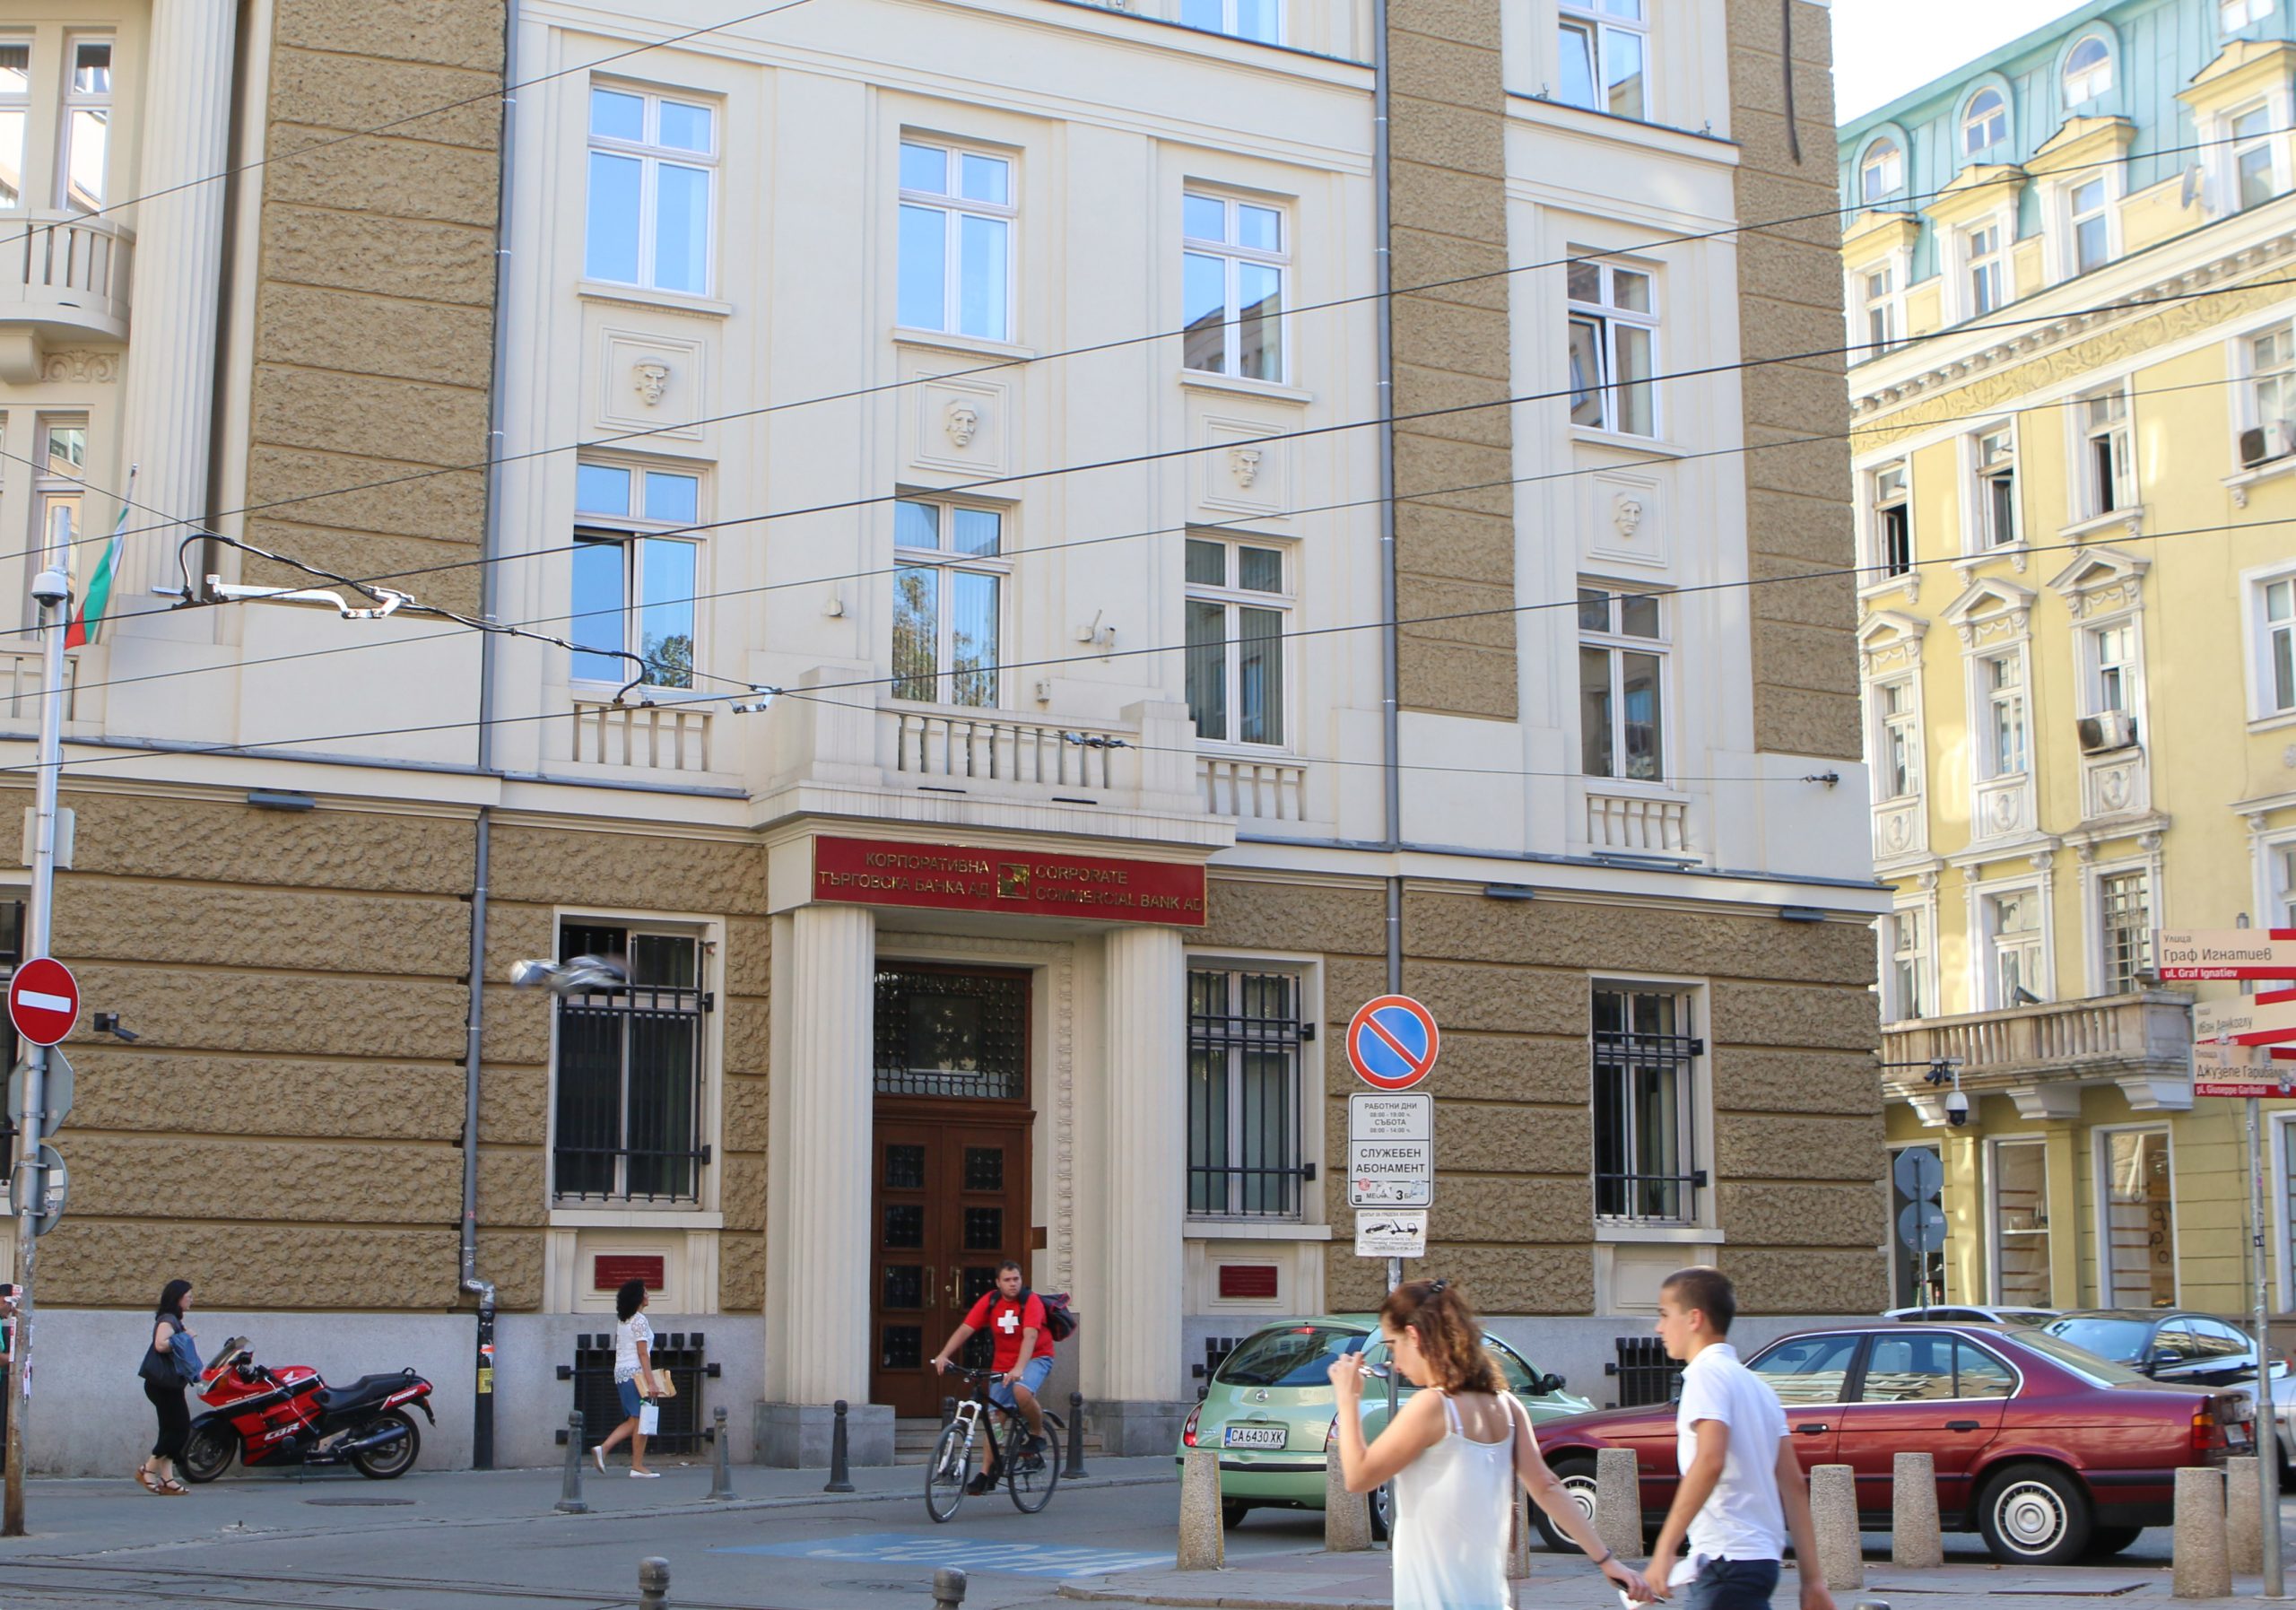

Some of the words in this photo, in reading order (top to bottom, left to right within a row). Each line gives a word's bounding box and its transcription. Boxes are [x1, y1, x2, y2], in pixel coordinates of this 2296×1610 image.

[865, 852, 990, 875] КОРПОРАТИВНА
[1035, 865, 1128, 884] CORPORATE
[819, 871, 911, 891] ТЪРГОВСКА
[915, 878, 965, 895] БАНКА
[968, 883, 990, 898] АД
[1035, 886, 1135, 906] COMMERCIAL
[1140, 893, 1179, 910] BANK
[1183, 898, 1204, 911] AD
[2164, 948, 2198, 963] Граф
[2203, 947, 2273, 962] Игнатиев
[2179, 969, 2198, 979] Graf
[2201, 968, 2238, 979] Ignatiev
[1401, 1102, 1417, 1110] ДНИ
[1360, 1148, 1422, 1158] СЛУЖЕБЕН
[1355, 1163, 1426, 1173] АБОНАМЕНТ
[1396, 1189, 1404, 1201] 3
[264, 1422, 300, 1440] CBR
[1231, 1430, 1244, 1441] CA
[1246, 1431, 1269, 1442] 6430
[1270, 1432, 1283, 1443] XK
